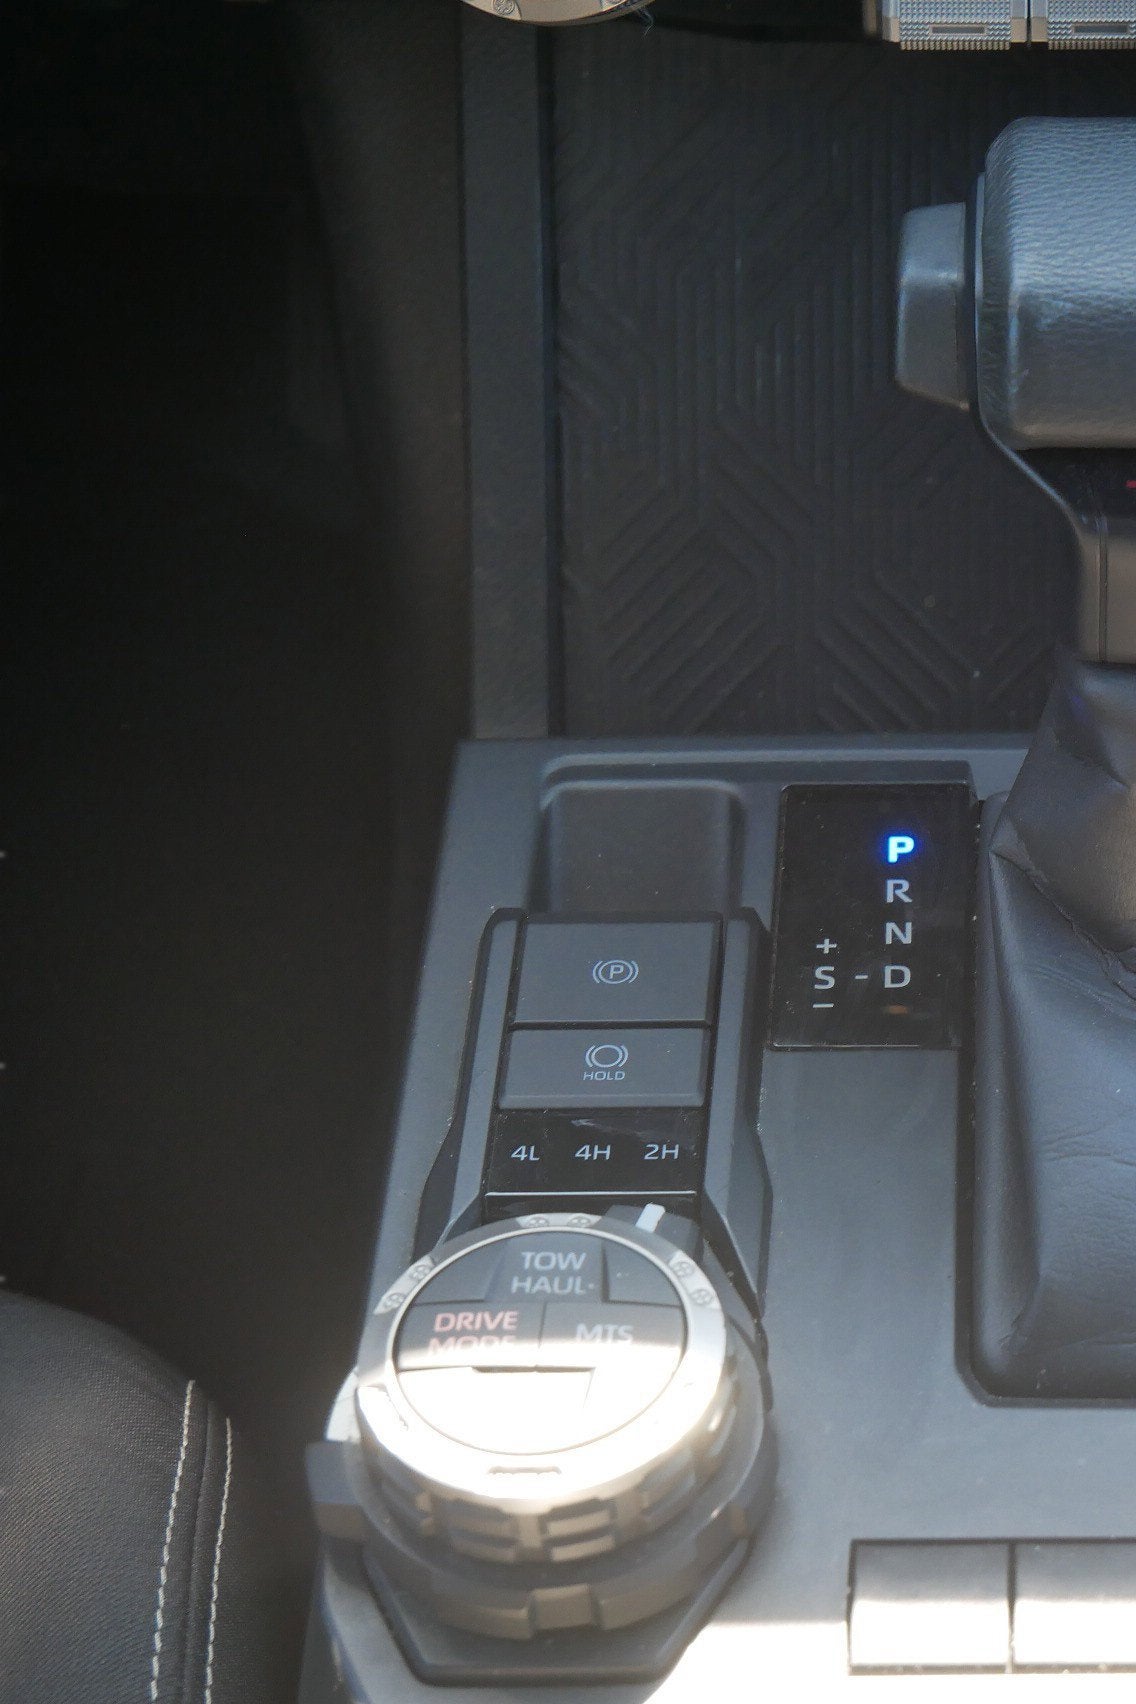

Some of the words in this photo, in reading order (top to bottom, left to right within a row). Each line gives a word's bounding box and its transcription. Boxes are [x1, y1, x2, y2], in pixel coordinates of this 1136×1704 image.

[887, 835, 915, 863] P
[886, 879, 913, 903] R
[885, 921, 912, 945] N
[814, 965, 836, 990] S
[884, 965, 911, 989] D
[582, 1070, 626, 1082] HOLD
[510, 1145, 540, 1161] 4L
[574, 1144, 611, 1161] 4H
[643, 1143, 679, 1160] 2H
[521, 1251, 587, 1271] TOW
[511, 1275, 586, 1295] HAUL
[434, 1311, 519, 1333] DRIVE
[574, 1323, 634, 1345] MTS
